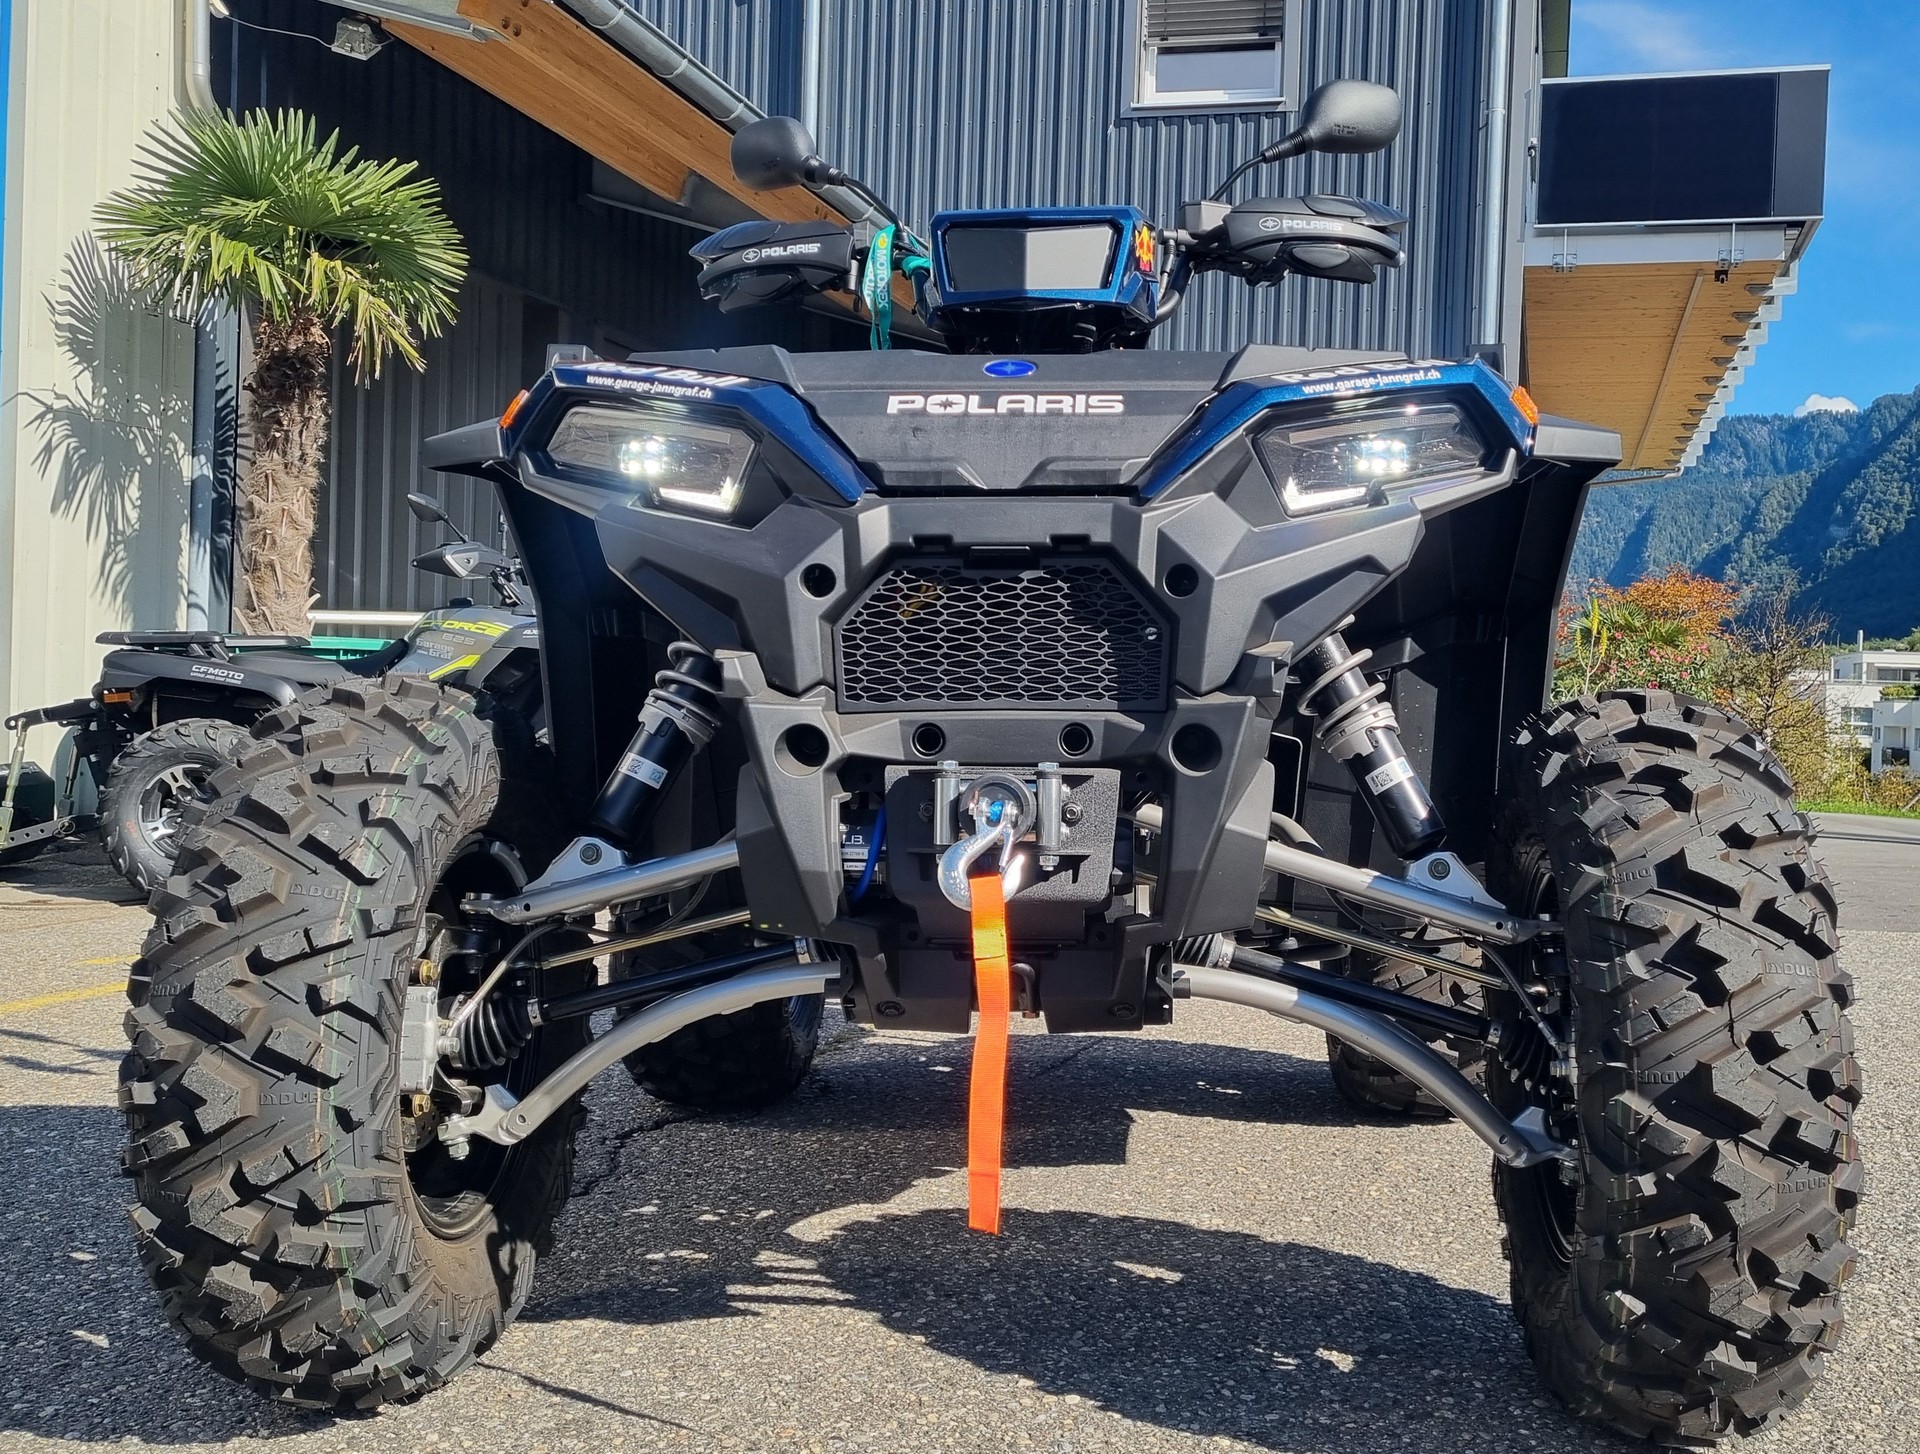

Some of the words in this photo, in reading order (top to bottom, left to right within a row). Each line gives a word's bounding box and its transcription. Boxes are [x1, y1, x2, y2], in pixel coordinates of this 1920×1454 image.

[1282, 219, 1344, 231] POLARIS
[761, 243, 821, 258] POLARIS
[875, 248, 890, 310] MOTOREX
[571, 361, 668, 375] Red
[654, 368, 750, 387] Bull
[1270, 366, 1369, 383] Red
[1301, 368, 1442, 395] www.garage-janngraf.ch
[586, 374, 713, 399] www.garage-janngraf.ch
[886, 393, 1125, 415] POLARIS
[416, 638, 455, 653] Garage
[442, 632, 476, 646] 625
[428, 647, 453, 660] Graf
[191, 664, 245, 680] CFMOTO
